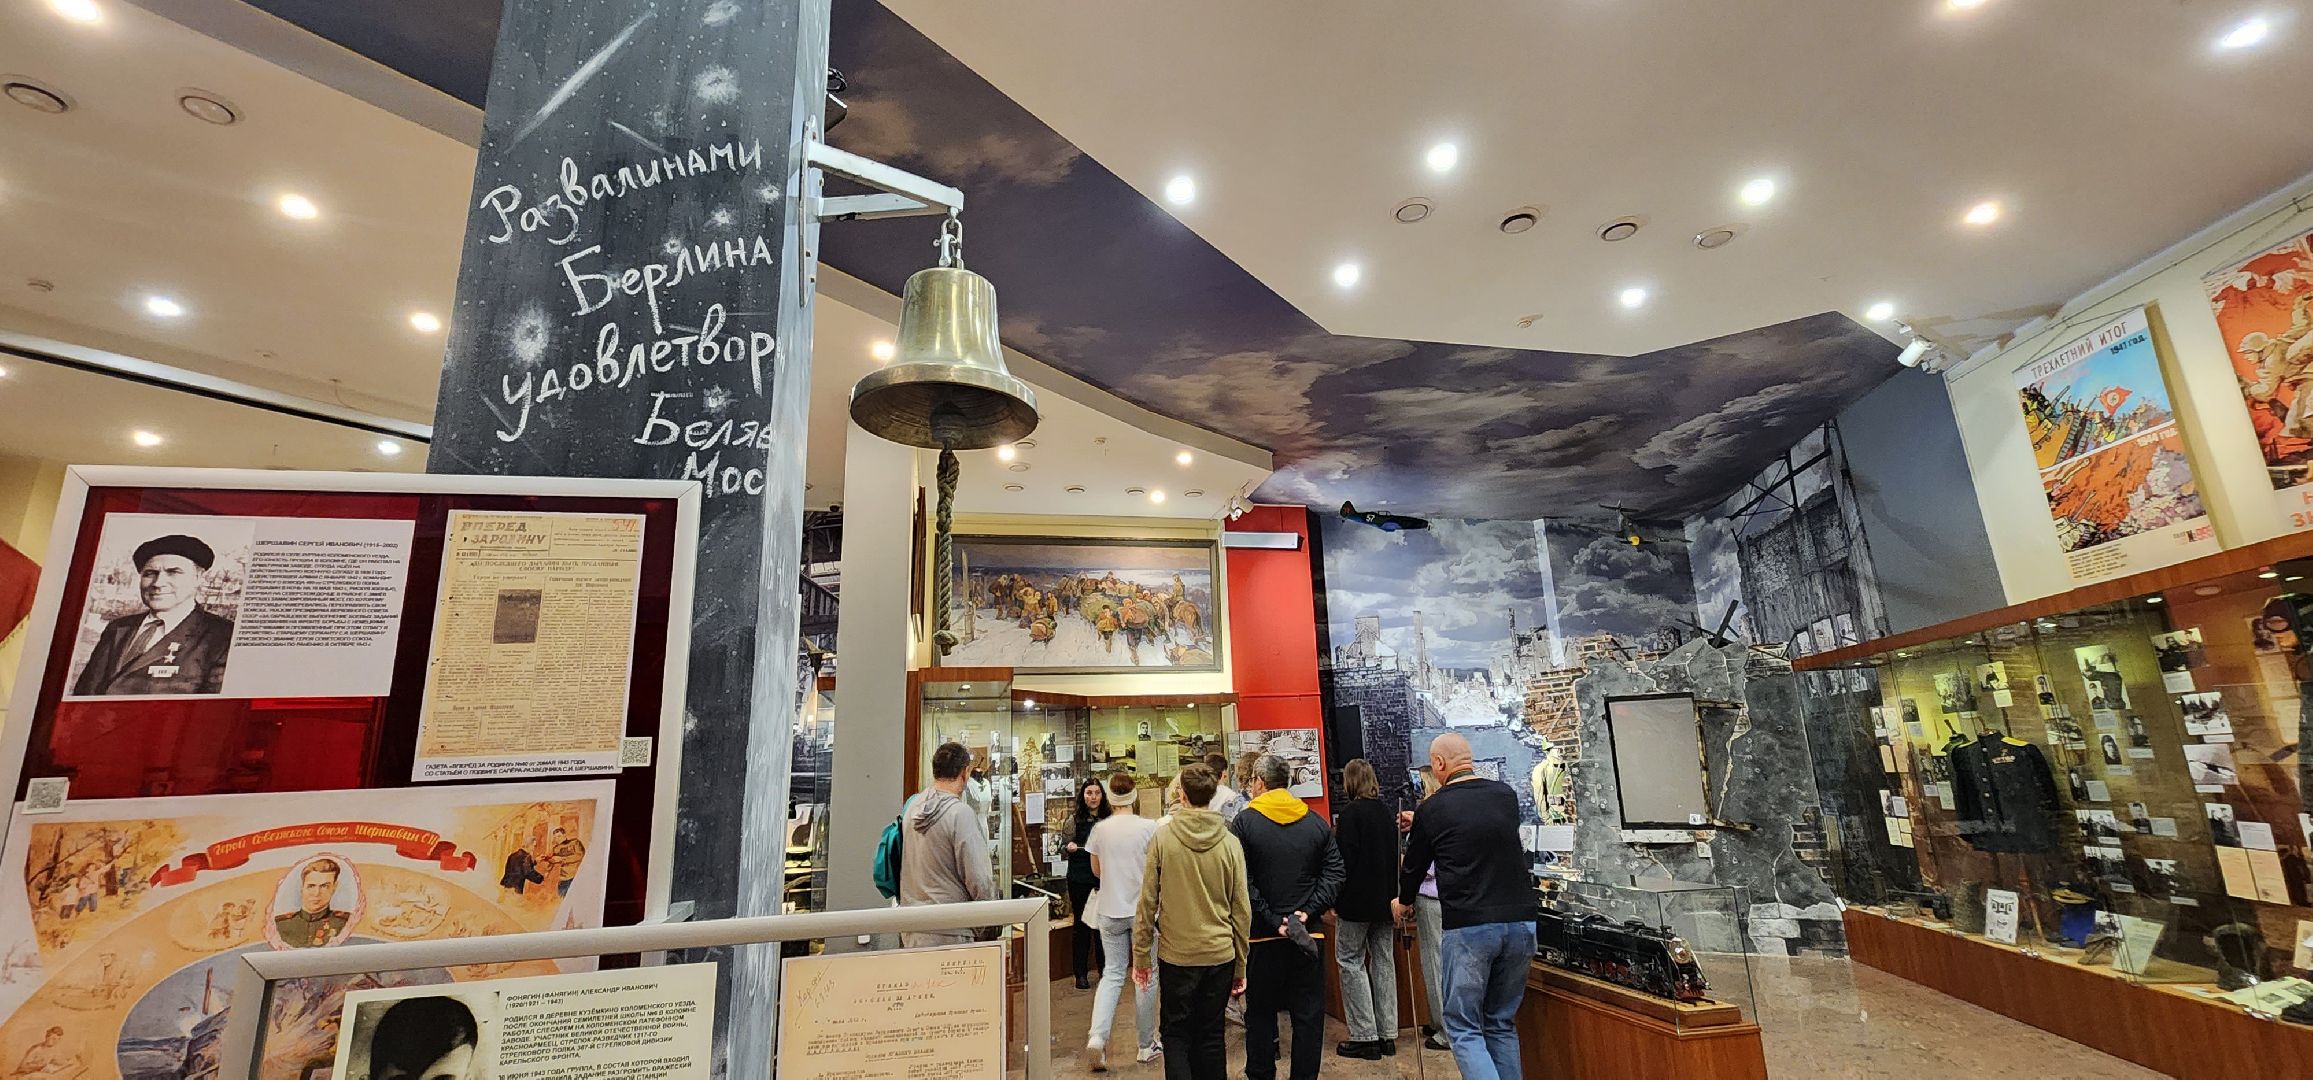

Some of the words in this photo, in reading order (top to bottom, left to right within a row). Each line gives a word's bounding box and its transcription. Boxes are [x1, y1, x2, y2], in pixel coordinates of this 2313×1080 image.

[480, 137, 762, 246] Развалинами
[553, 234, 774, 336] Берлина
[2031, 338, 2094, 379] ТРЕХЛЕТНИЙ
[2098, 322, 2128, 346] ИТОГ
[214, 838, 246, 855] Герой
[252, 828, 312, 845] Советского
[316, 825, 349, 836] Союза
[355, 824, 419, 842] Шершавин
[542, 990, 578, 998] (ФАНЯГИН)
[580, 987, 620, 995] АЛЕКСАНДР
[622, 983, 658, 992] ИВАНОВИЧ
[504, 1014, 537, 1023] РОДИЛСЯ
[546, 1010, 577, 1019] ДЕРЕВНЕ
[579, 1007, 618, 1016] КУЗЁМКИНО
[620, 1002, 673, 1012] КОЛОМЕНСКОГО
[529, 1018, 571, 1028] ОКОНЧАНИЯ
[573, 1014, 618, 1023] СЕМИЛЕТНЕЙ
[665, 1007, 697, 1015] КОЛОМНЕ
[503, 1028, 534, 1037] РАБОТАЛ
[536, 1025, 573, 1034] СЛЕСАРЕМ
[586, 1019, 637, 1029] КОЛОМЕНСКОМ
[639, 1015, 684, 1024] ПАТЕФОННОМ
[533, 1032, 569, 1041] УЧАСТНИК
[570, 1029, 602, 1038] ВЕЛИКОЙ
[604, 1024, 661, 1034] ОТЕЧЕСТВЕННОЙ
[500, 1048, 550, 1059] СТРЕЛКОВОГО
[552, 1046, 575, 1054] ПОЛКА
[596, 1039, 640, 1049] СТРЕЛКОВОЙ
[642, 1036, 673, 1044] ДИВИЗИИ
[500, 1055, 549, 1065] КАРЕЛЬСКОГО
[507, 1072, 529, 1080] ИЮНЯ
[603, 1061, 629, 1070] СОСТАВ
[631, 1058, 662, 1067] КОТОРОЙ
[663, 1055, 690, 1064] ВХОДИЛ
[574, 1070, 605, 1080] ЗАДАНИЕ
[608, 1066, 650, 1076] РАЗГРОМИТЬ
[652, 1062, 692, 1072] ВРАЖЕСКИЙ
